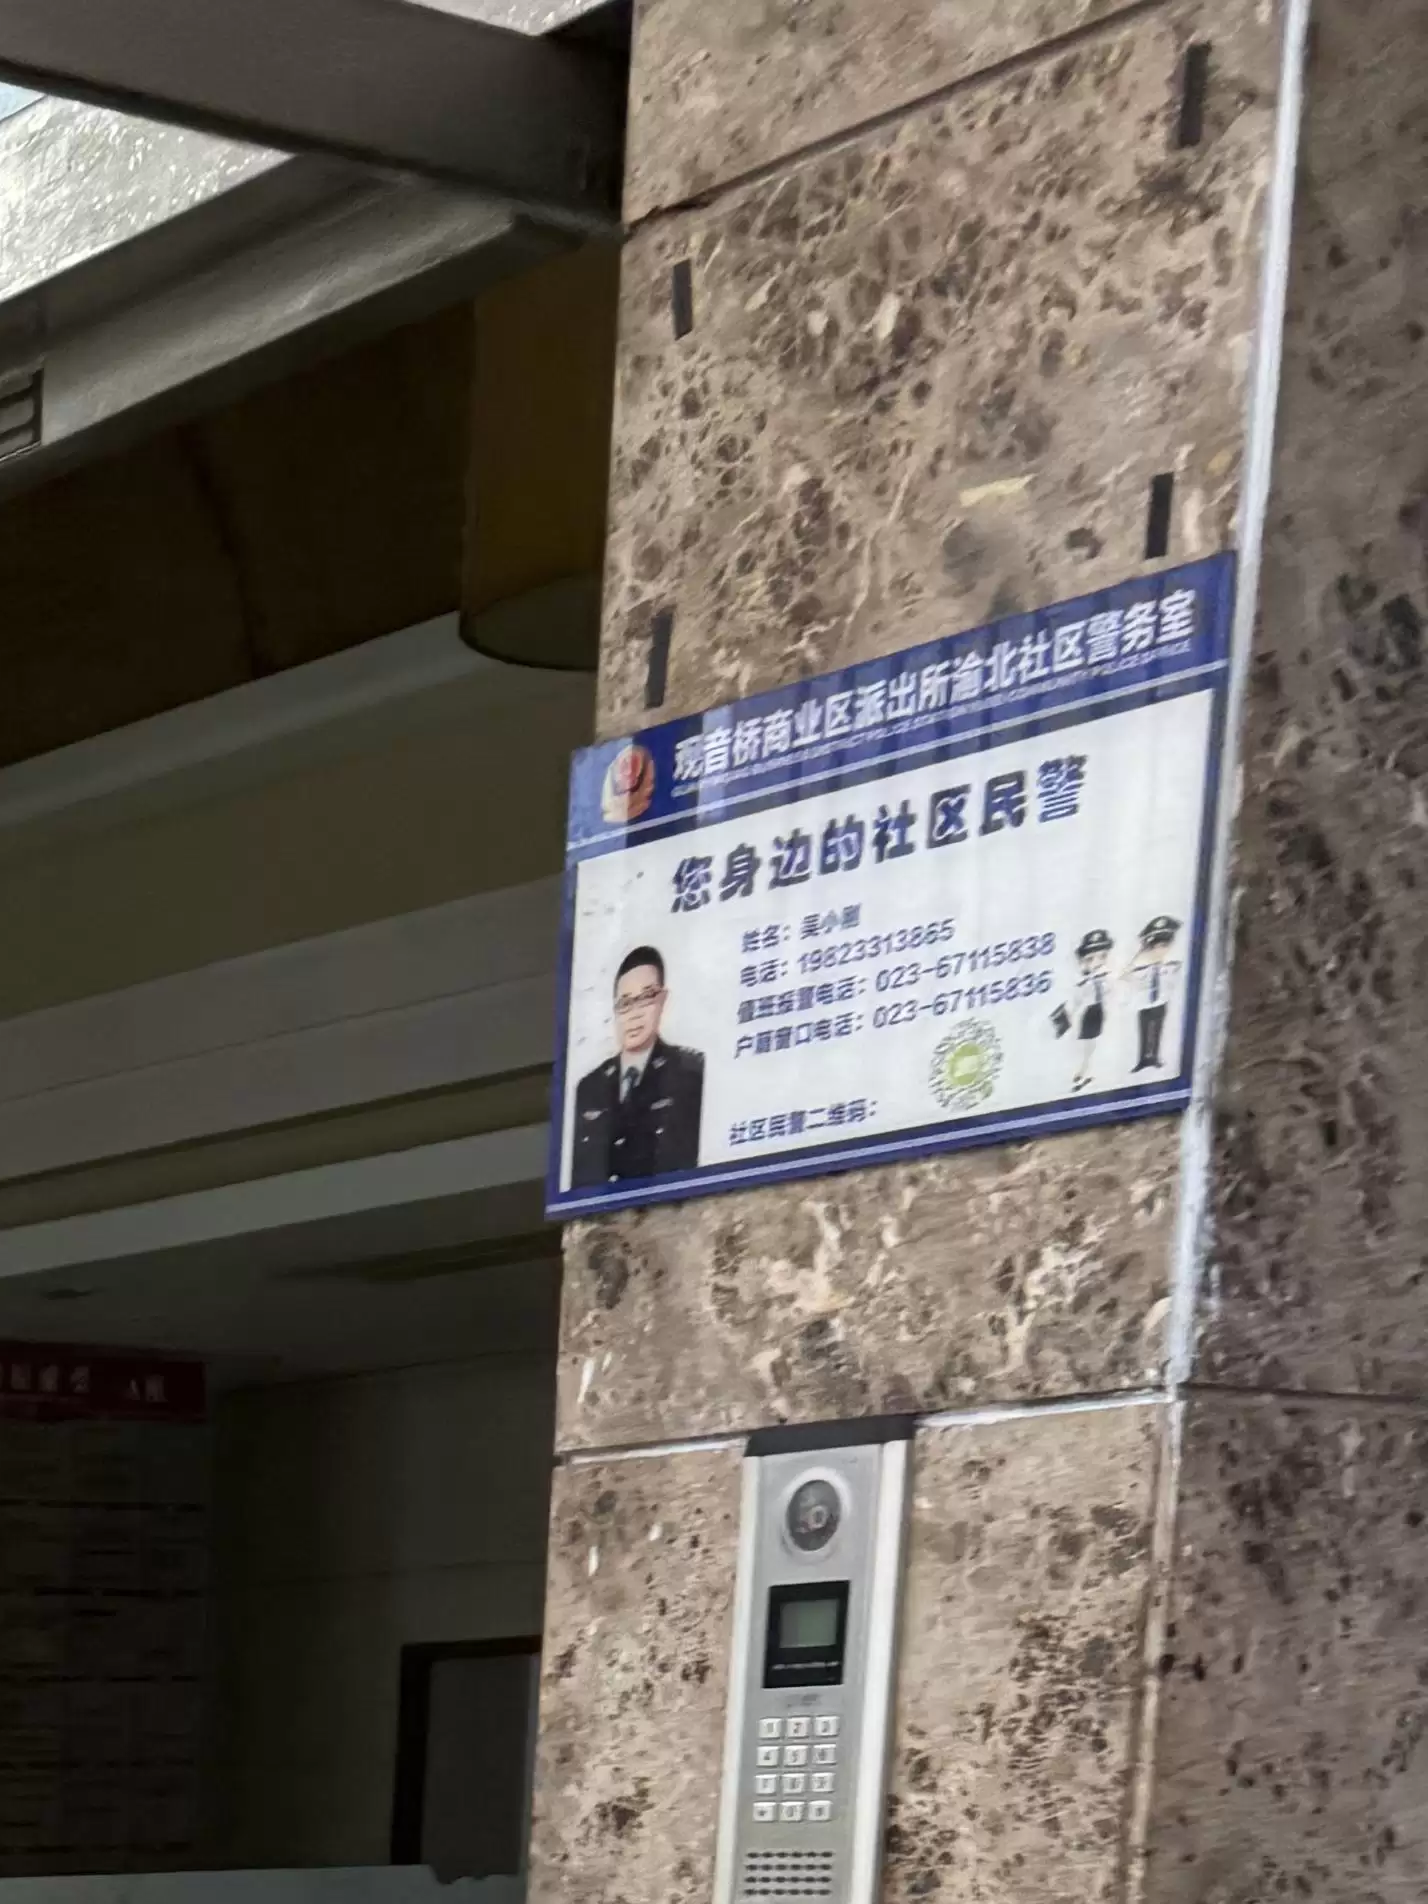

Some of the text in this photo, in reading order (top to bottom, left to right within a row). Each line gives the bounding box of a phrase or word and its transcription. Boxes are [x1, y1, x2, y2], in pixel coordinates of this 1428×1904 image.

[670, 754, 1088, 913] 您身边的社区民警
